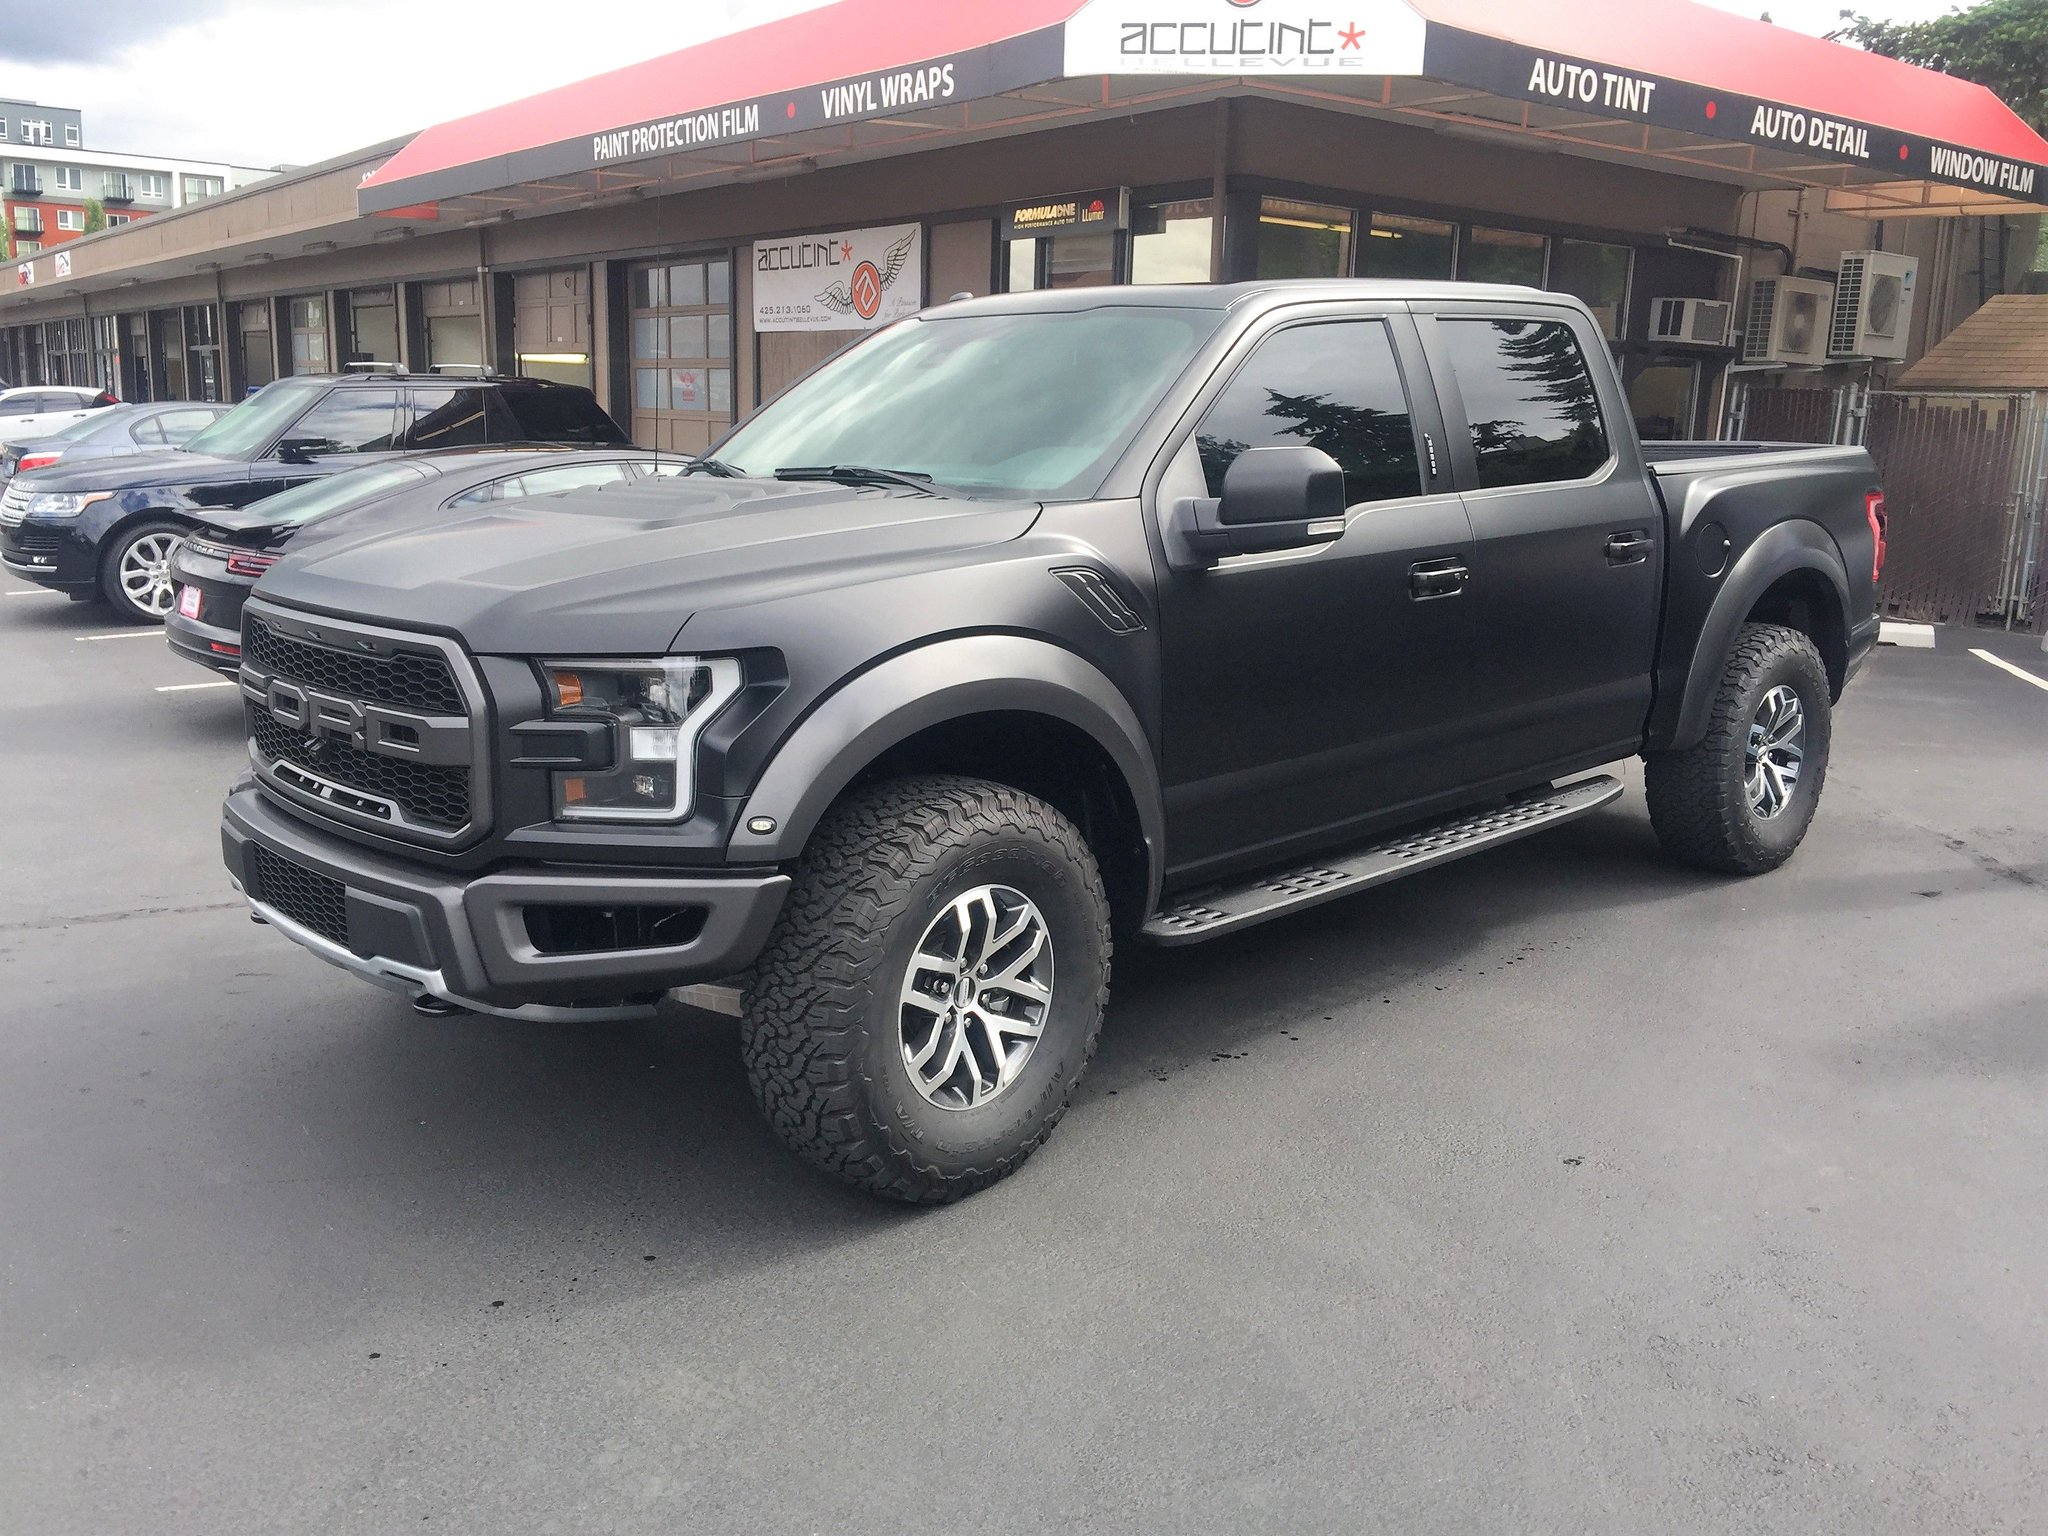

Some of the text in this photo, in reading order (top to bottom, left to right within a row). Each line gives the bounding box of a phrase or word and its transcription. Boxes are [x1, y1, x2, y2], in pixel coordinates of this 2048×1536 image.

[593, 63, 955, 161] PAINT PROTECTION FILM VINYL WRAPS
[1528, 57, 2035, 194] AUTO TINT AUTO DETAIL WINDOW FILM
[1053, 218, 1065, 226] AUTO
[759, 304, 811, 315] 425.213.1060
